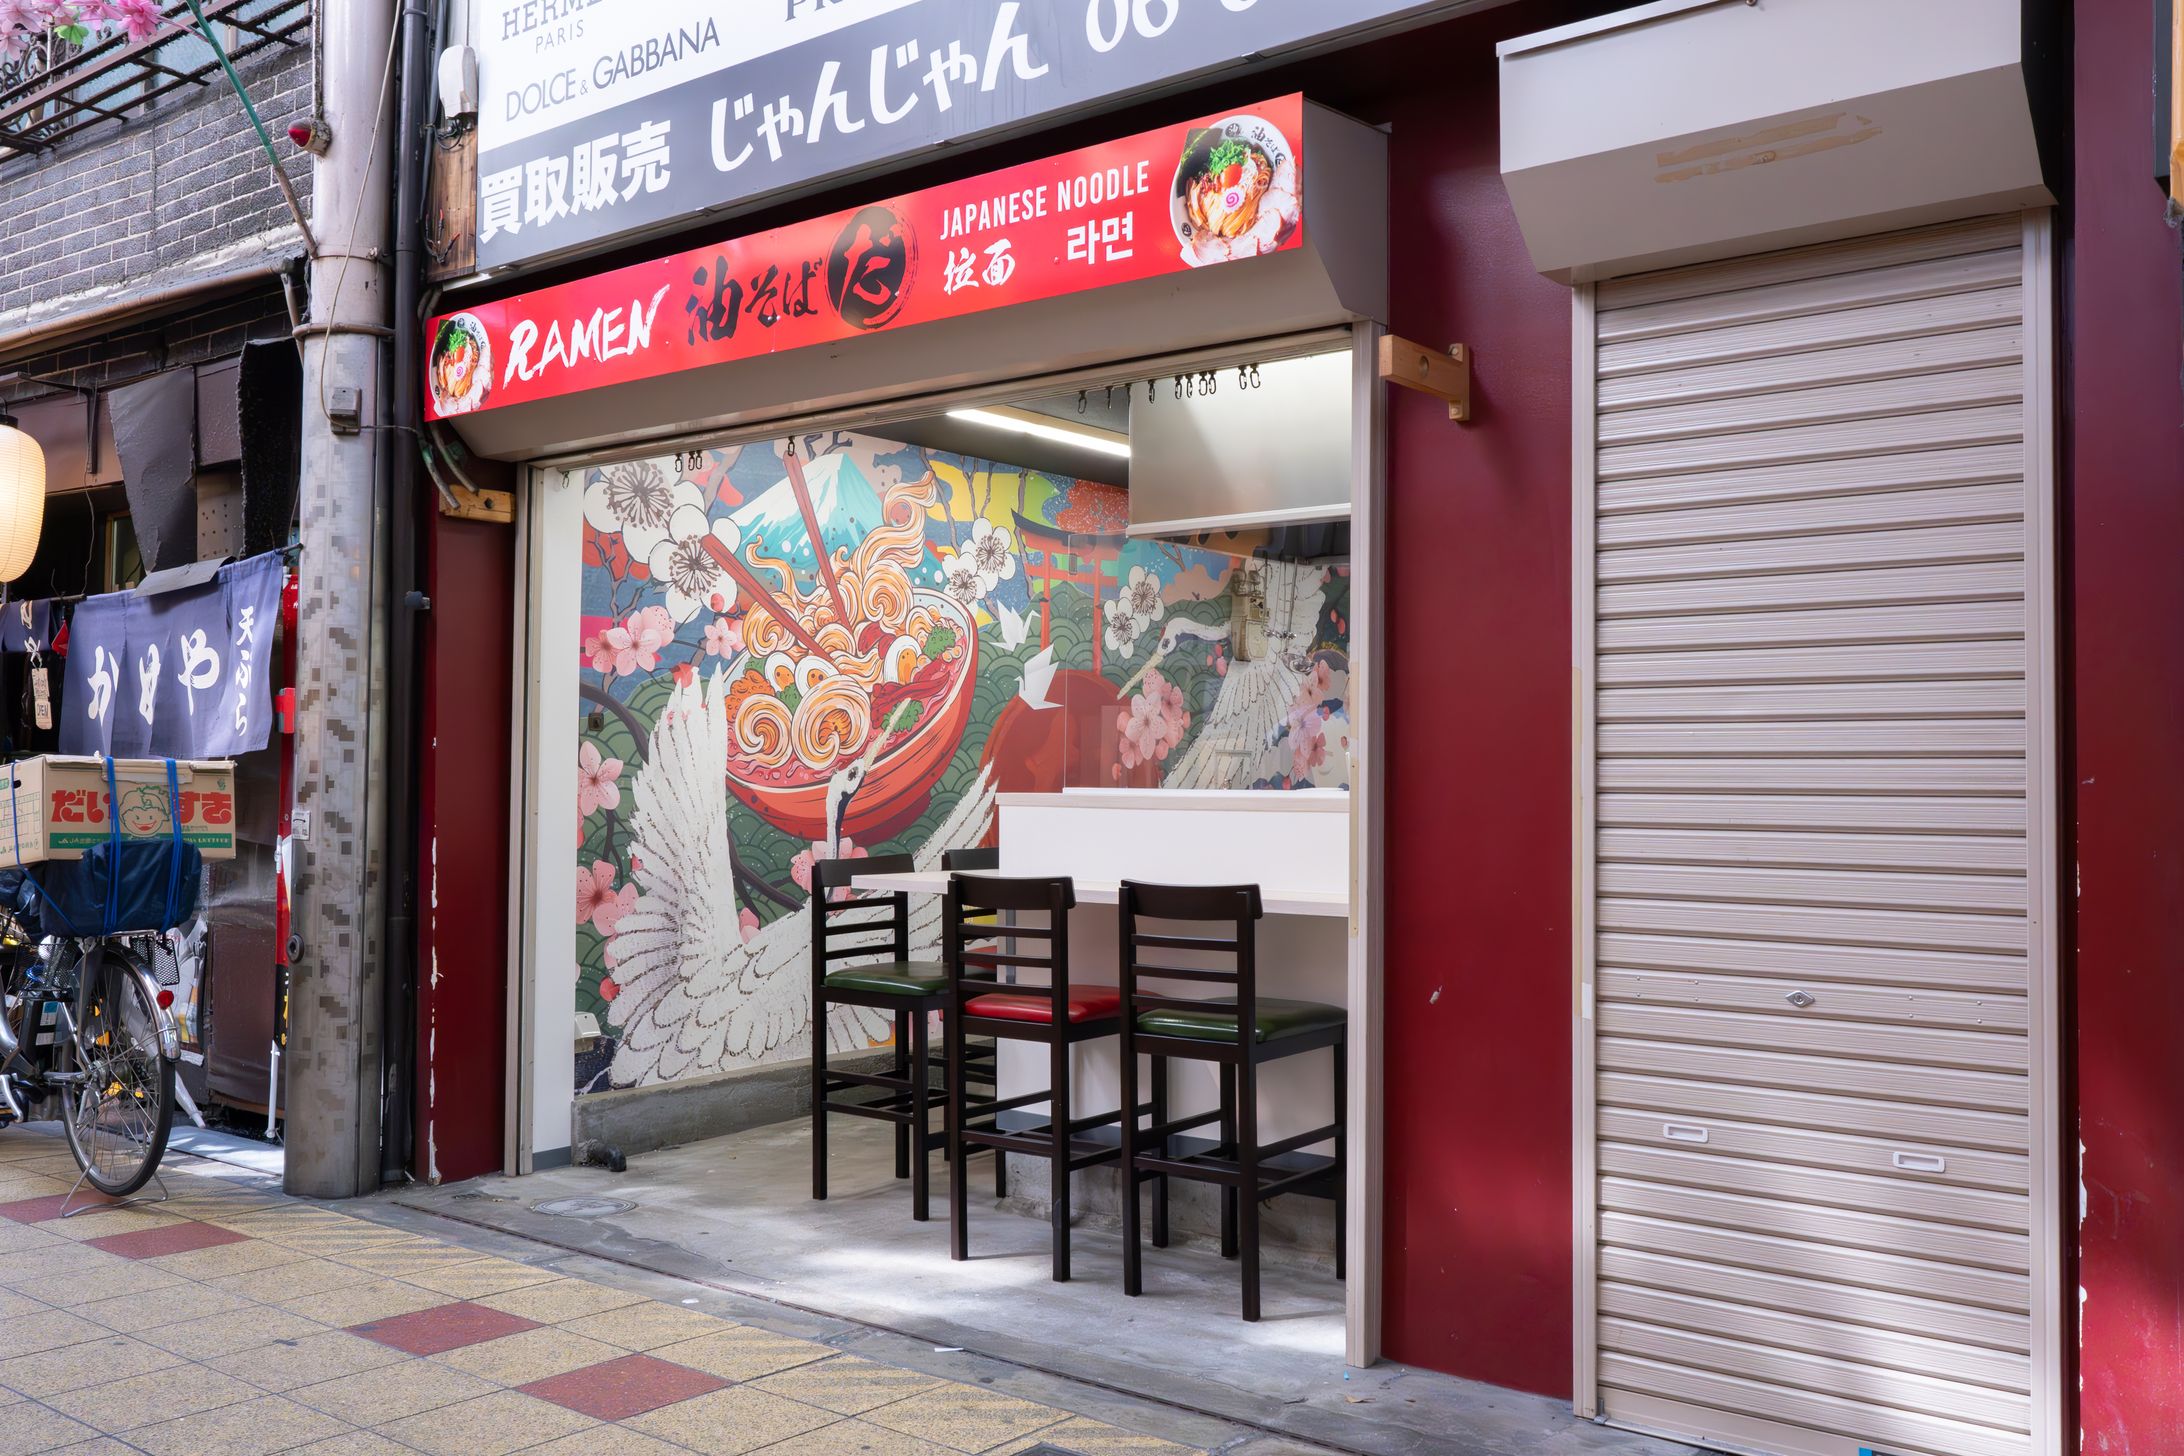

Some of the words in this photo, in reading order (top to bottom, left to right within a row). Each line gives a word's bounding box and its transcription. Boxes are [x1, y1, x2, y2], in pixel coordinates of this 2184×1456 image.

[506, 68, 576, 122] DOLCE
[579, 79, 589, 95] &
[592, 17, 720, 89] GABBANA
[535, 19, 584, 54] PARIS
[479, 119, 671, 244] 買取販売
[711, 2, 1048, 172] じゃんじゃん
[940, 185, 1047, 240] JAPANESE
[1057, 160, 1149, 212] NOODLE
[1067, 211, 1133, 264] 라면
[685, 255, 822, 346] 油そば
[943, 238, 1016, 295] 拉面
[503, 284, 670, 390] RAMEN
